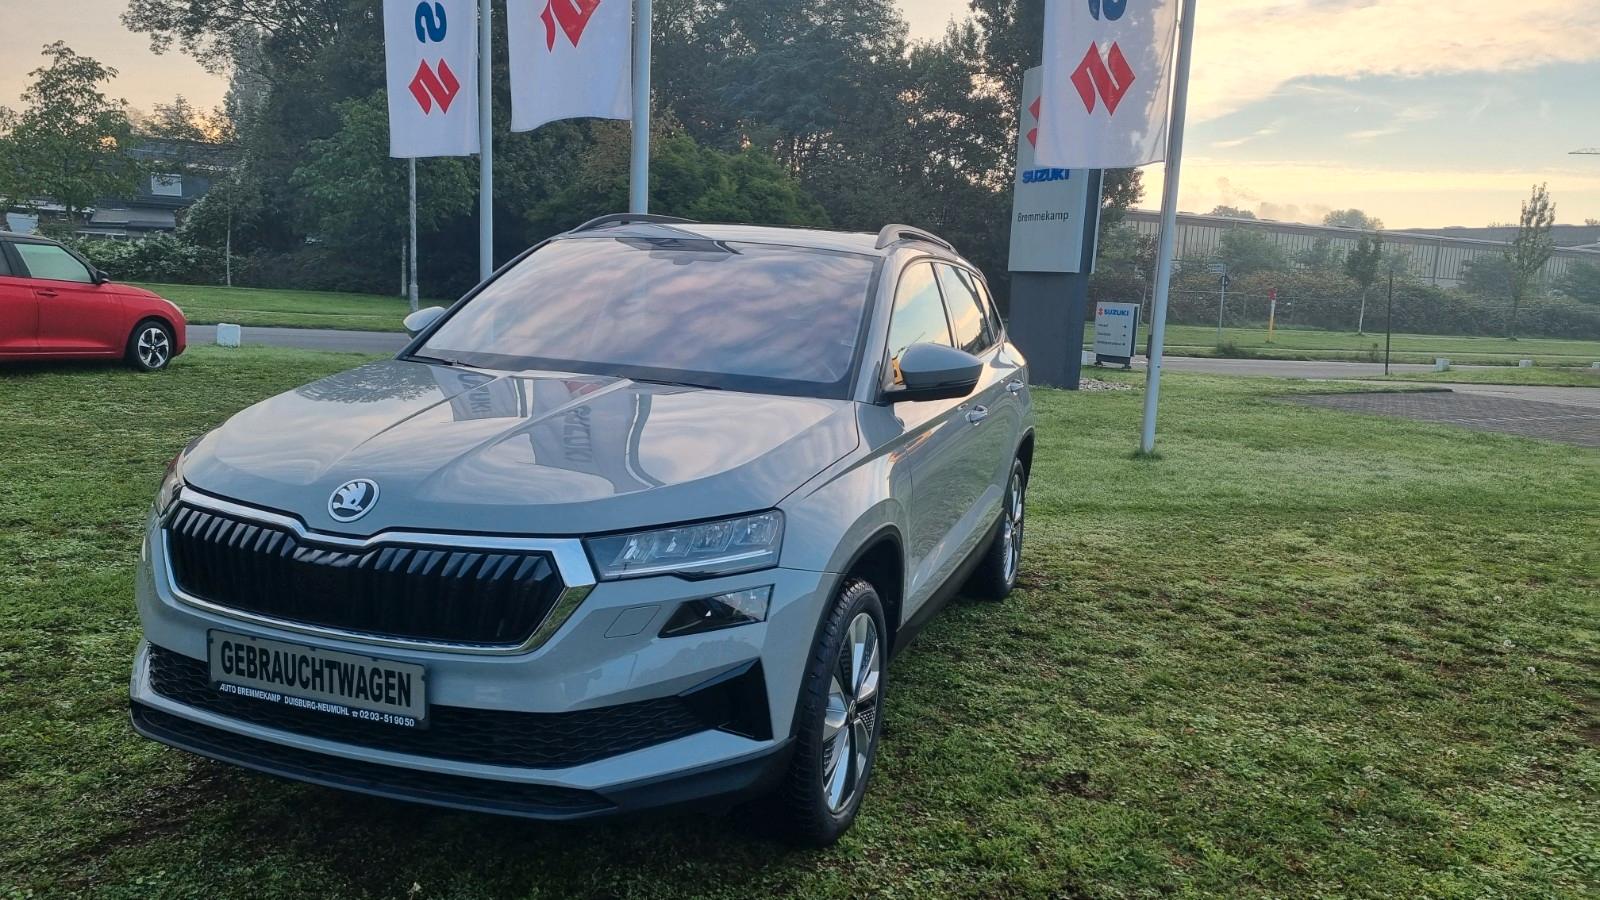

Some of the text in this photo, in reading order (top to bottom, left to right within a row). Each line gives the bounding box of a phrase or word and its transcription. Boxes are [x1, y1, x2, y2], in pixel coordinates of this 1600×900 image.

[1022, 168, 1070, 184] SUZUKI
[1017, 211, 1069, 222] Bremmekamp
[1104, 308, 1129, 316] SUZUKI
[220, 640, 412, 708] GEBRAUCHTWAGEN
[219, 683, 237, 694] AUTO
[237, 686, 281, 703] BREMMEKAMP
